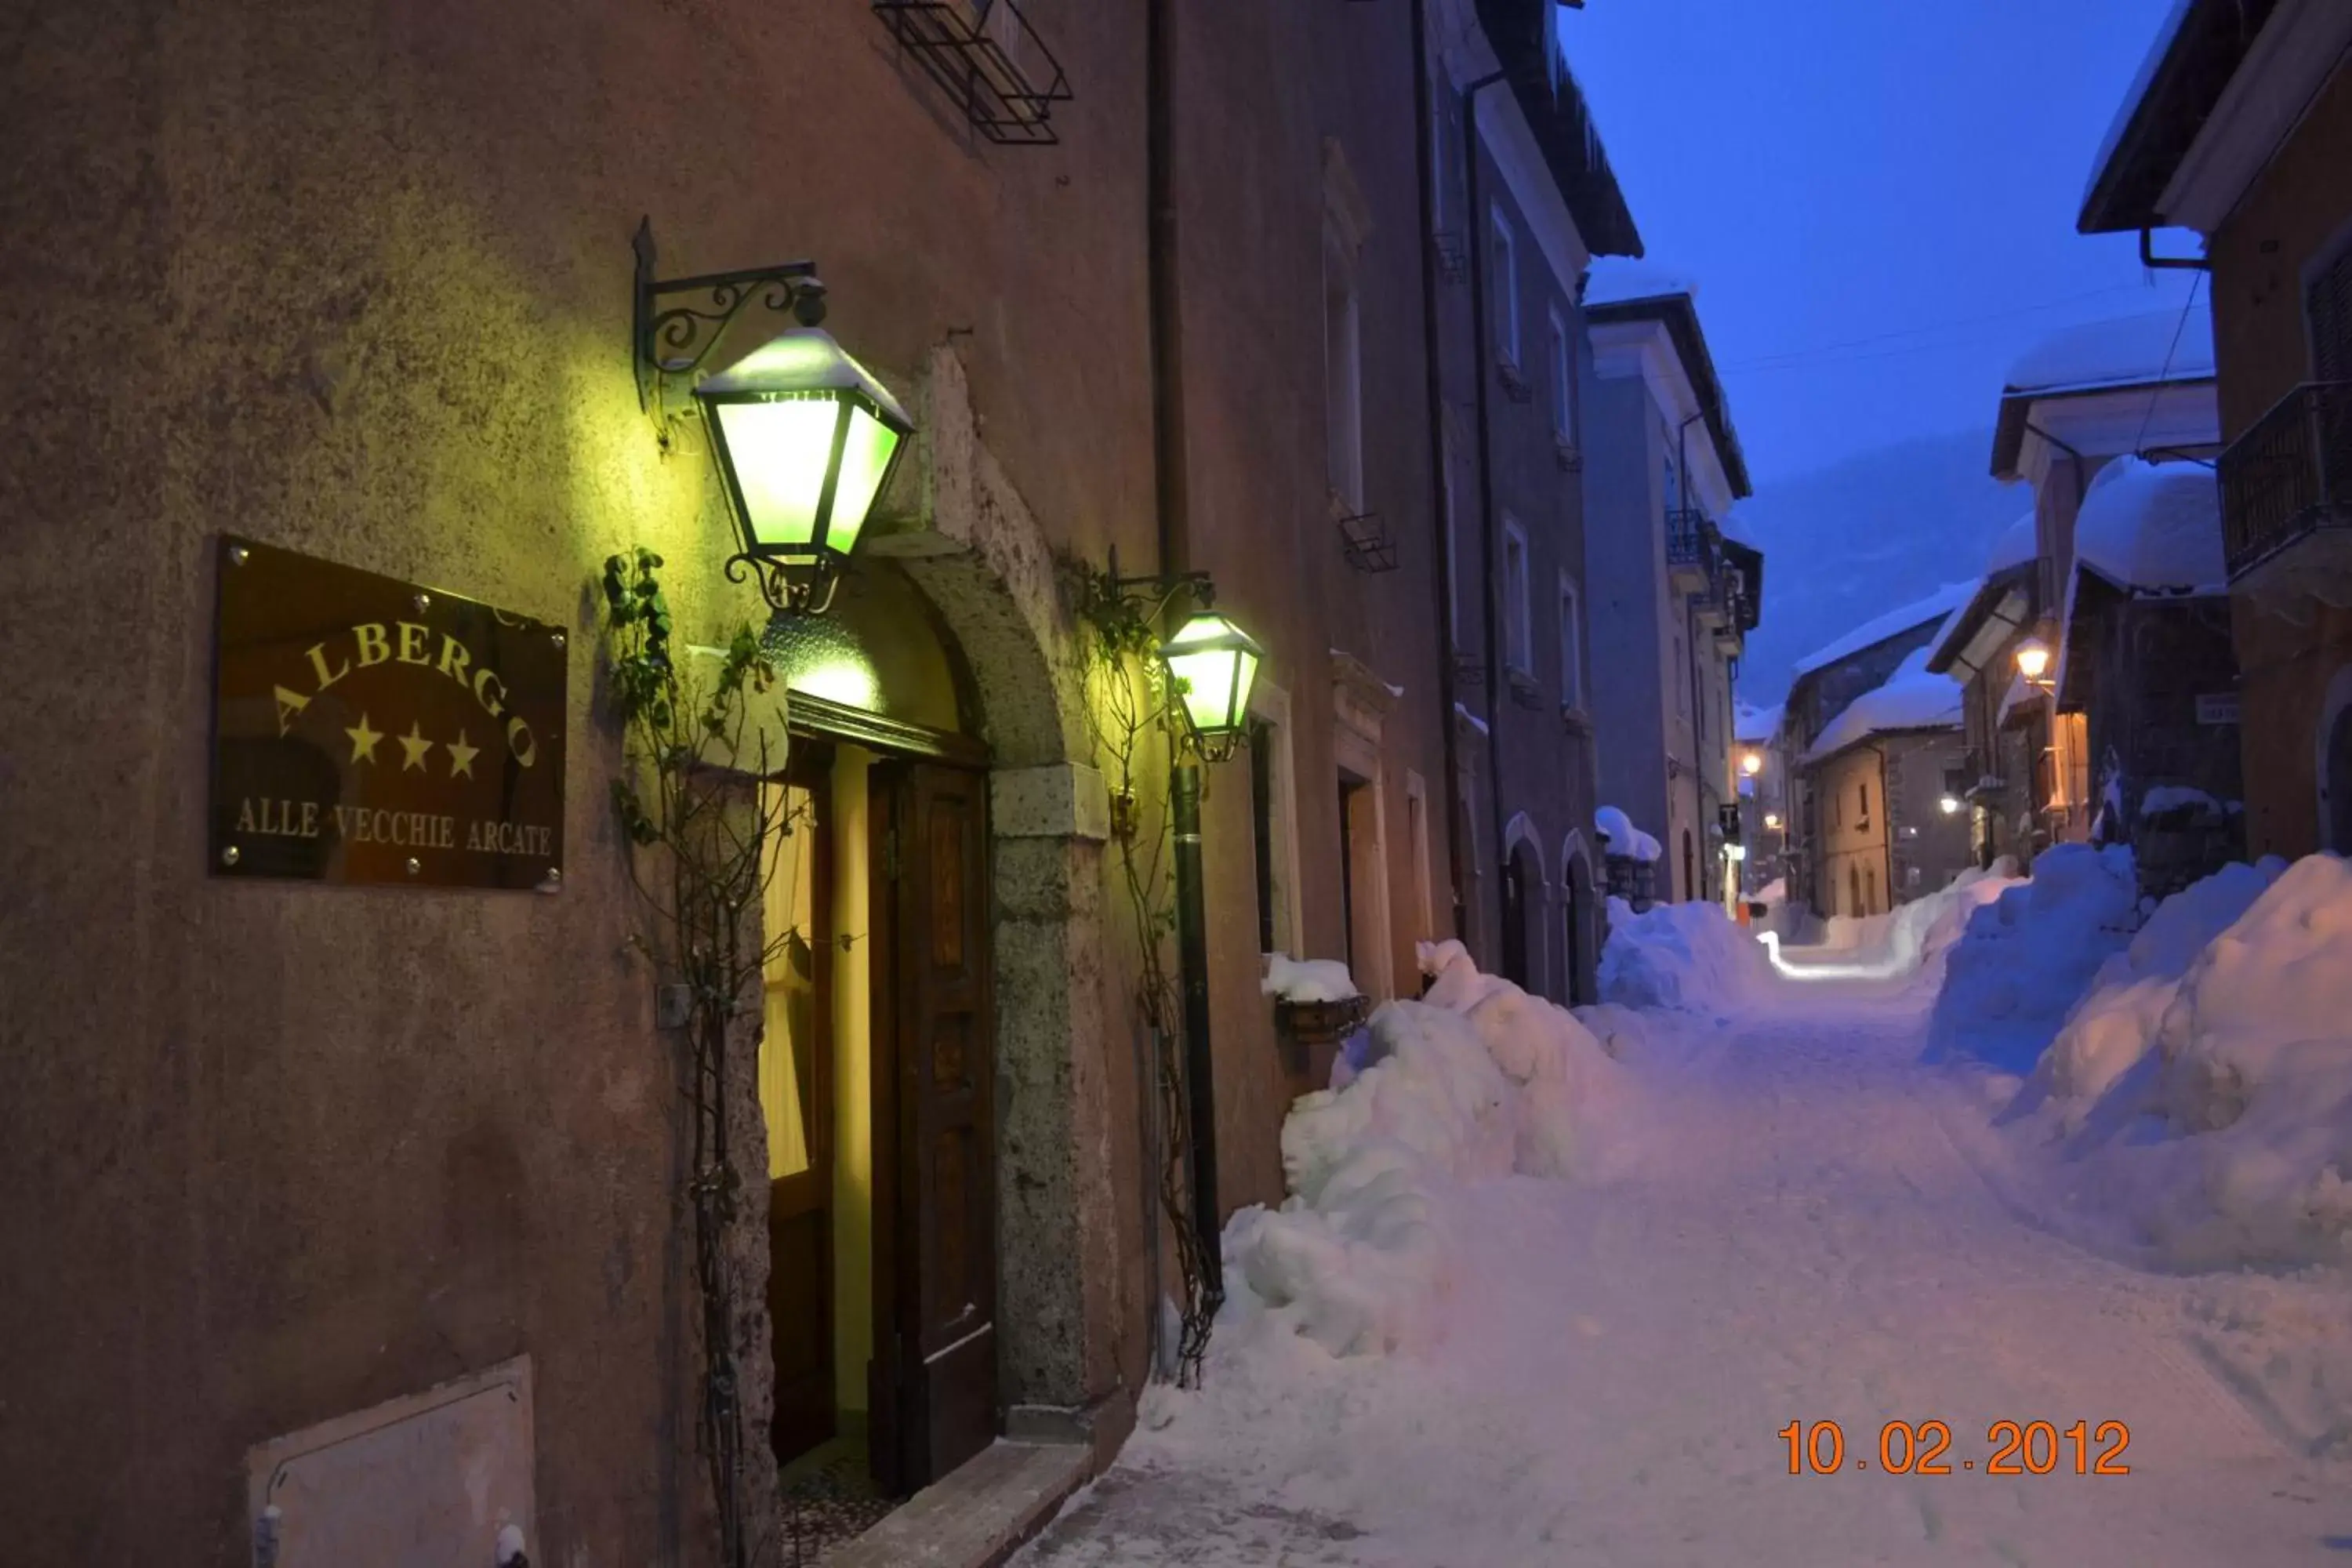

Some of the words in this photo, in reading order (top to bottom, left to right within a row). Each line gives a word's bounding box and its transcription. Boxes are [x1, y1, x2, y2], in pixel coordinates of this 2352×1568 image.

[273, 621, 537, 768] ALBERGO
[237, 797, 319, 838] ALLE
[333, 804, 454, 848] VECCHIE
[466, 821, 551, 856] ARCATE
